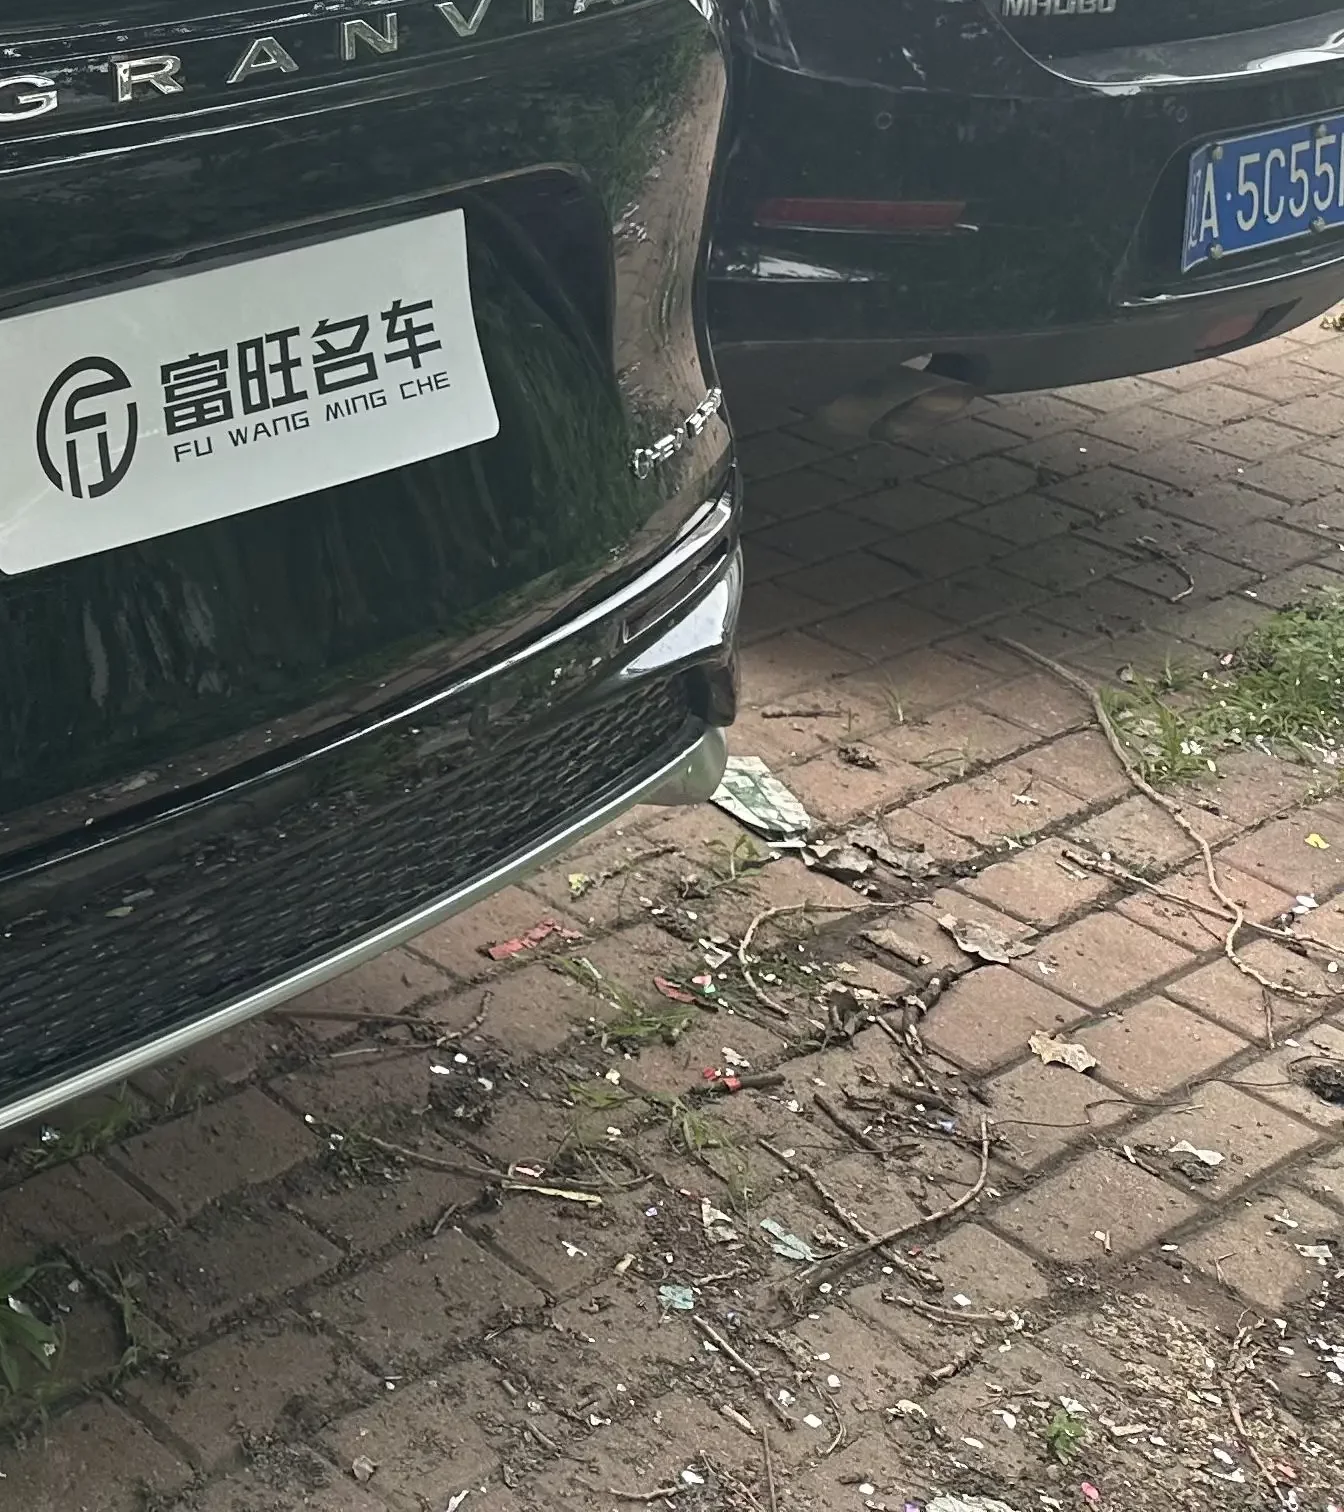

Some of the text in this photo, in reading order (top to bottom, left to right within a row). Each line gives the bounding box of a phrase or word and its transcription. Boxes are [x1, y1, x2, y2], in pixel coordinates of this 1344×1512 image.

[159, 298, 443, 437] 富旺名车
[173, 371, 452, 464] FU WANG MING CHE
